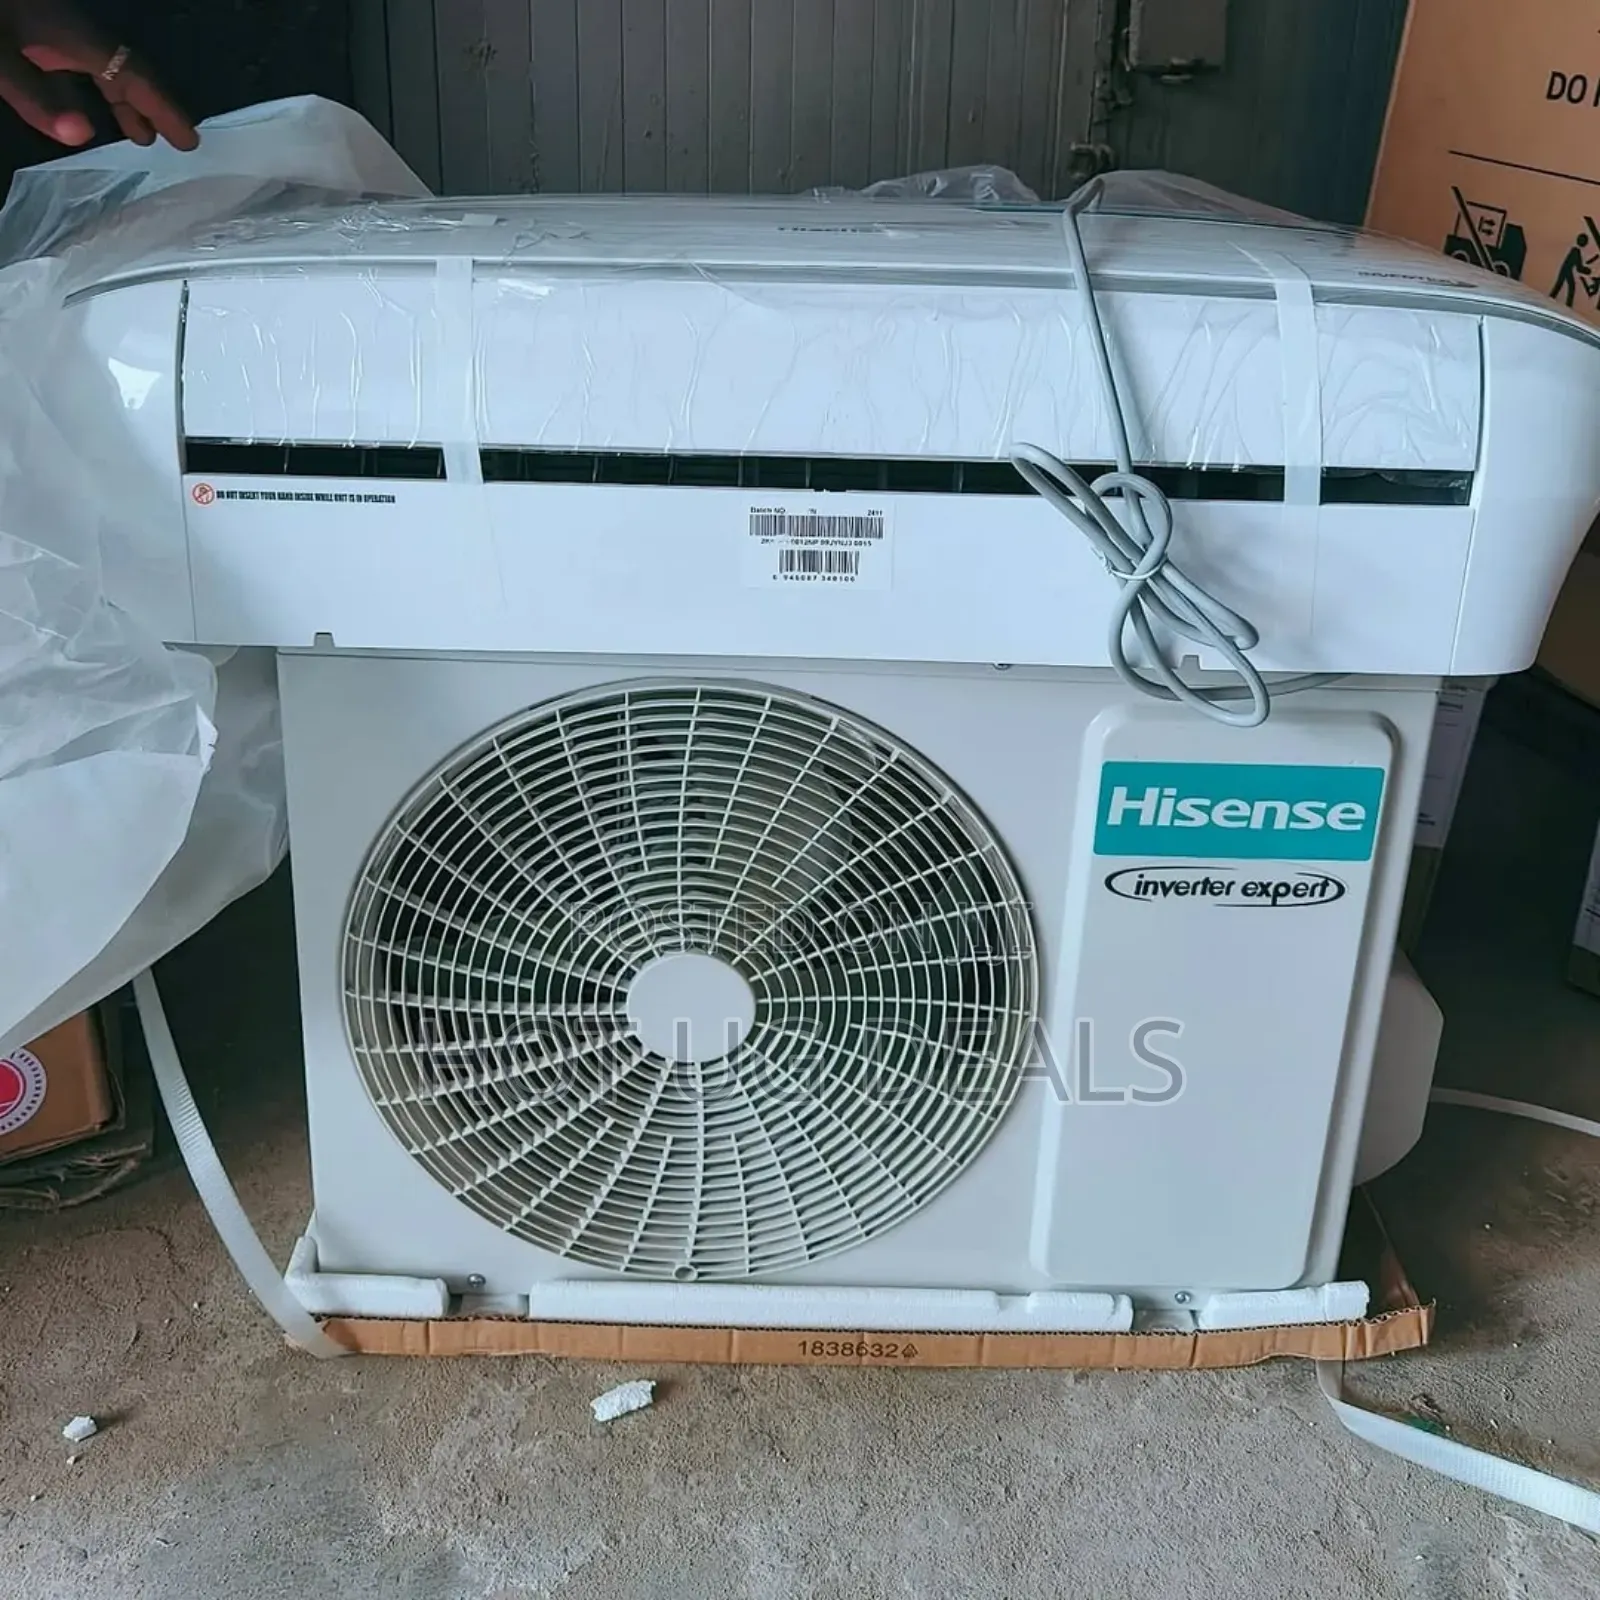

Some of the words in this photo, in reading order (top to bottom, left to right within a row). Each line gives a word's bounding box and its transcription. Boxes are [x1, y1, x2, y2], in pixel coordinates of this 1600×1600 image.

[1546, 70, 1588, 105] DO
[1107, 786, 1367, 831] Hisense
[1134, 873, 1236, 898] inverter
[1241, 877, 1331, 907] expert
[797, 1340, 899, 1359] 1838632
